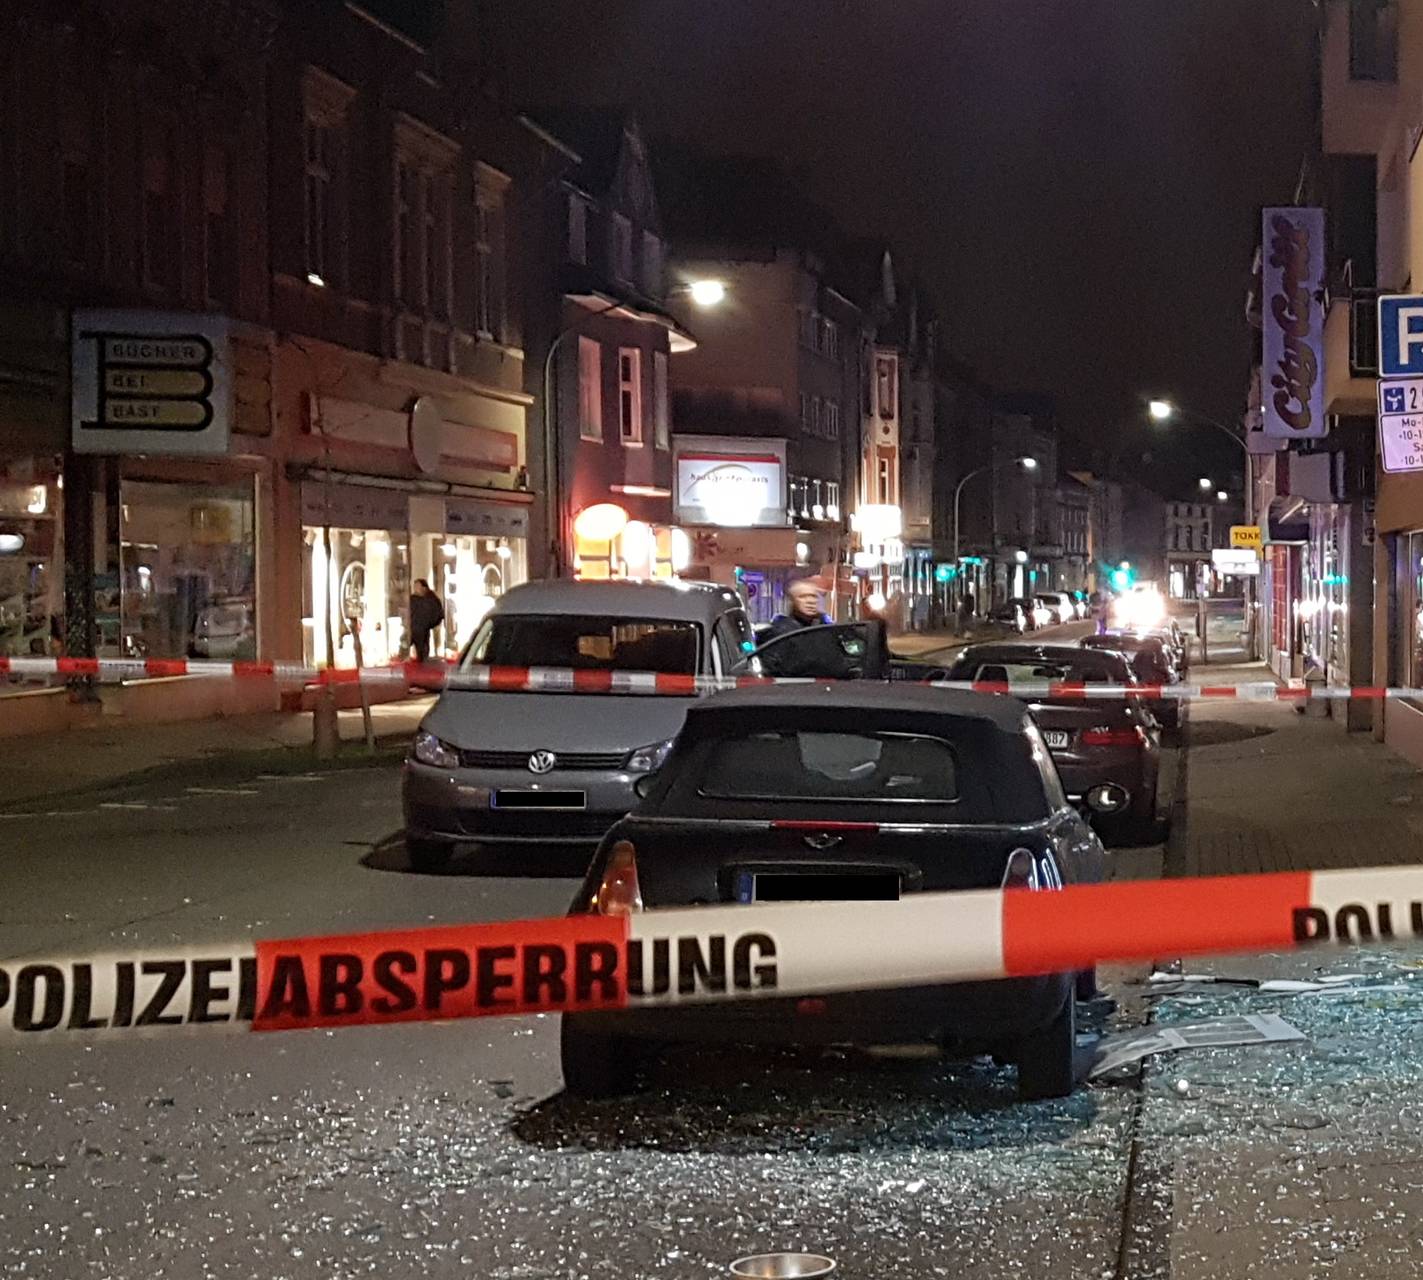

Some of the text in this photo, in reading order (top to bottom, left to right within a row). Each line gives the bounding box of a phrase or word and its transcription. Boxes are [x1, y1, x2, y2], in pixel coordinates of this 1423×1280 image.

[112, 374, 146, 388] BEI
[1410, 387, 1417, 409] 2
[0, 933, 778, 1031] OLIZEIABSPERRUNG
